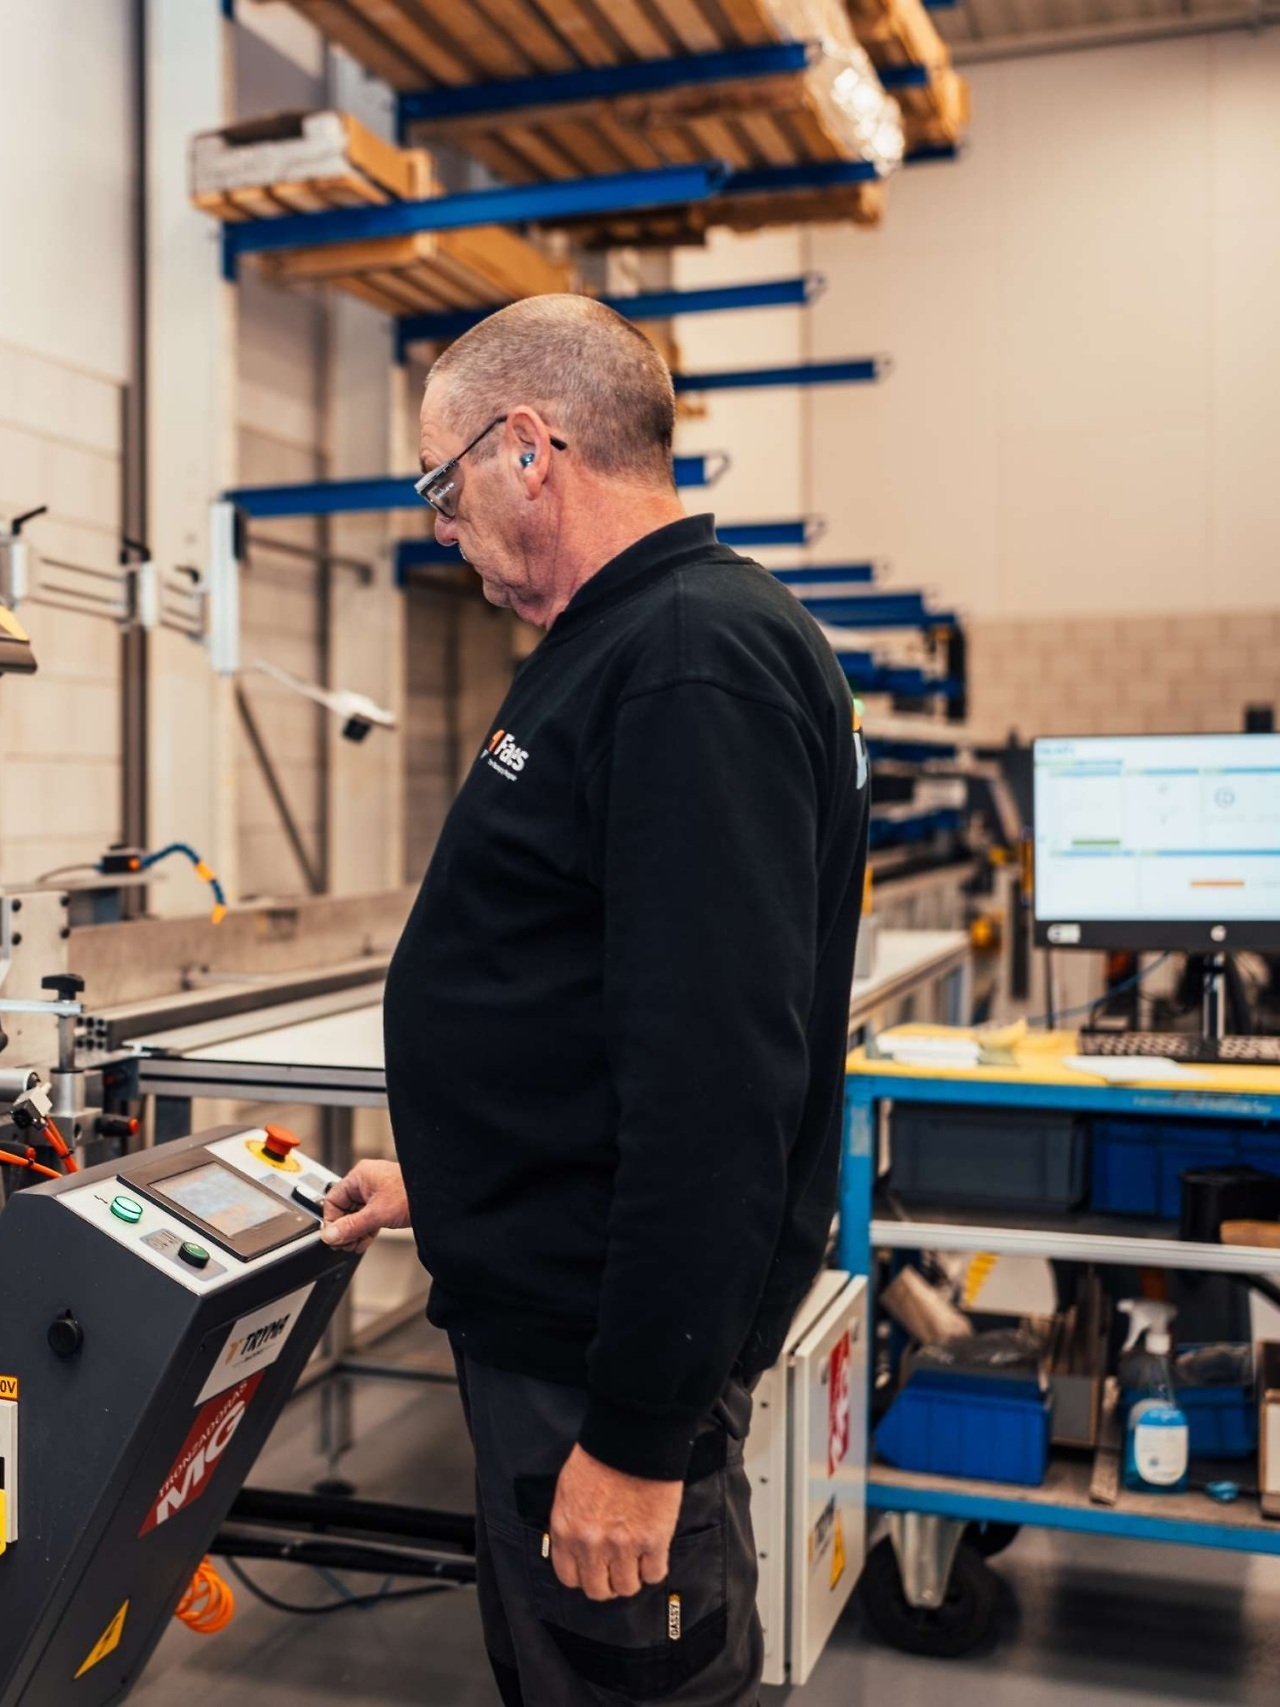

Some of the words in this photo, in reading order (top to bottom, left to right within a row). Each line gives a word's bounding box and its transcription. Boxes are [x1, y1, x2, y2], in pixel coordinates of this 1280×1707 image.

[241, 1314, 291, 1356] TRYMA
[157, 1400, 245, 1525] MG
[159, 1381, 247, 1498] TRONZADORAS
